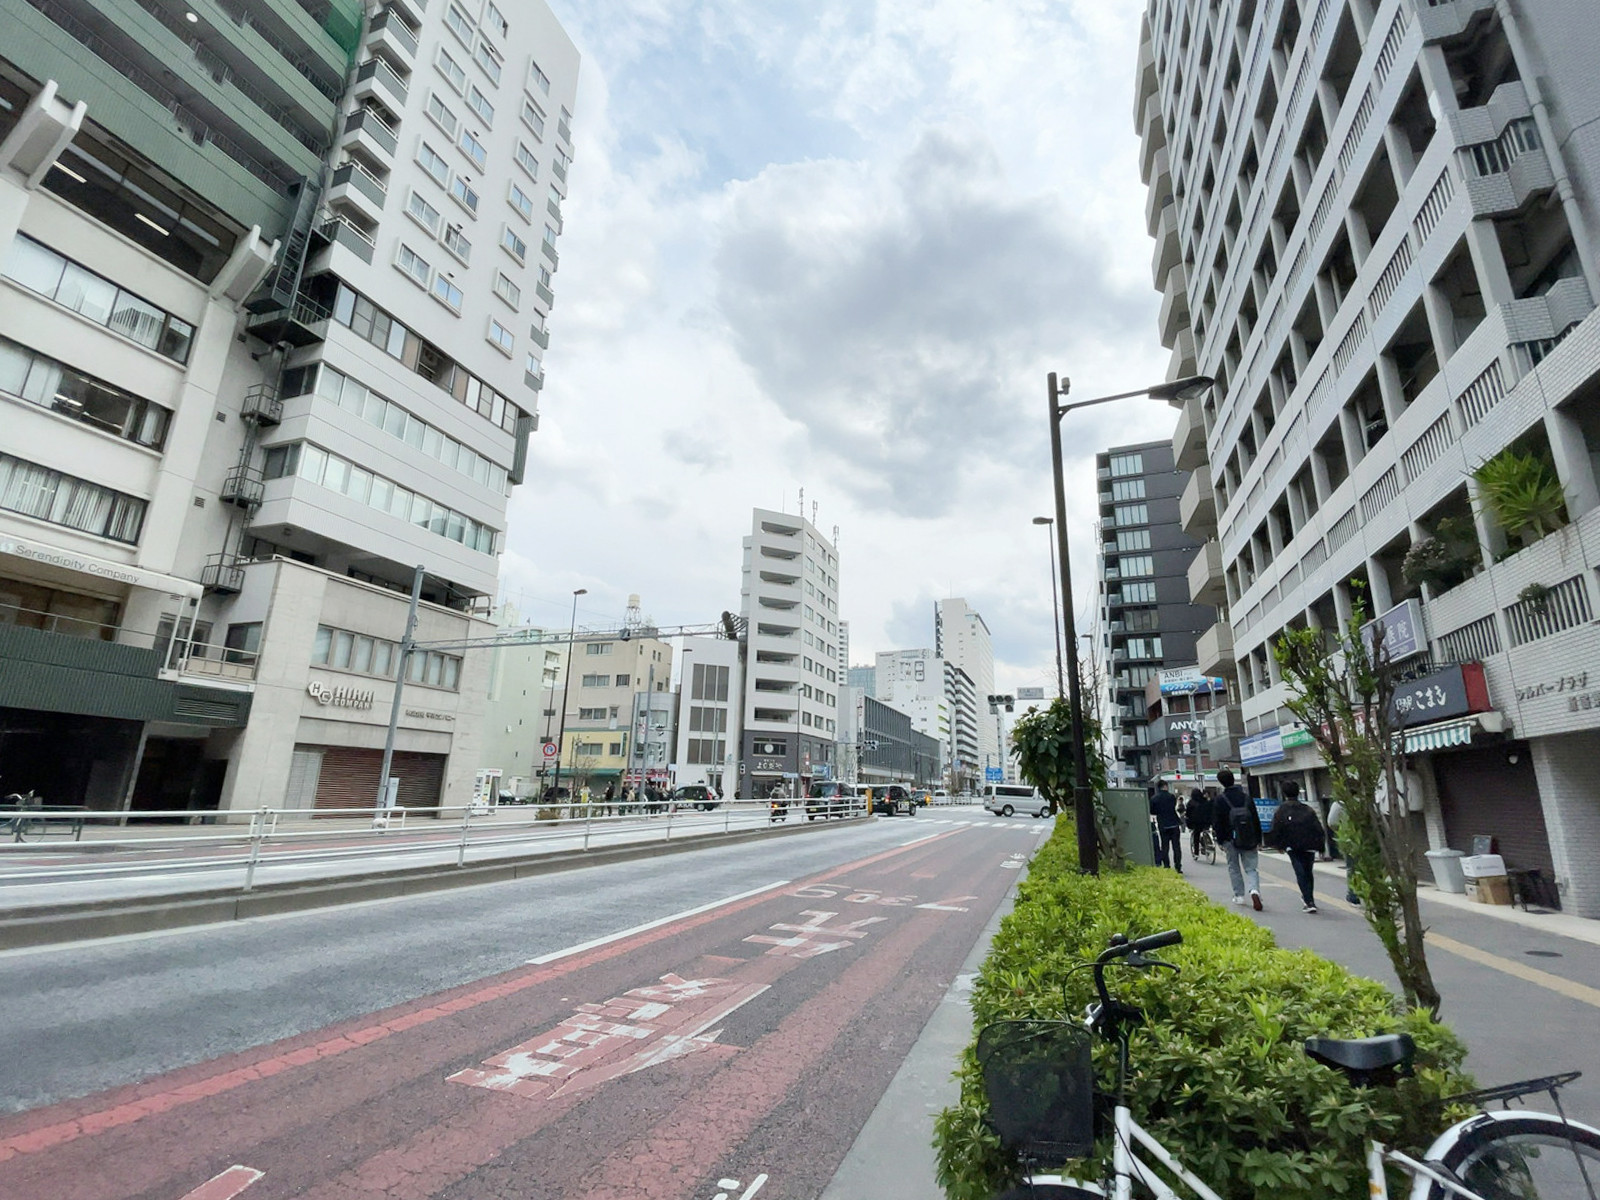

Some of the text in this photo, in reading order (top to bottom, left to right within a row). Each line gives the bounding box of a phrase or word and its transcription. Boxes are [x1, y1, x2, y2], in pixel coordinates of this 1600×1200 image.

[15, 544, 141, 584] Serendipity Company
[334, 697, 373, 710] COMPAN
